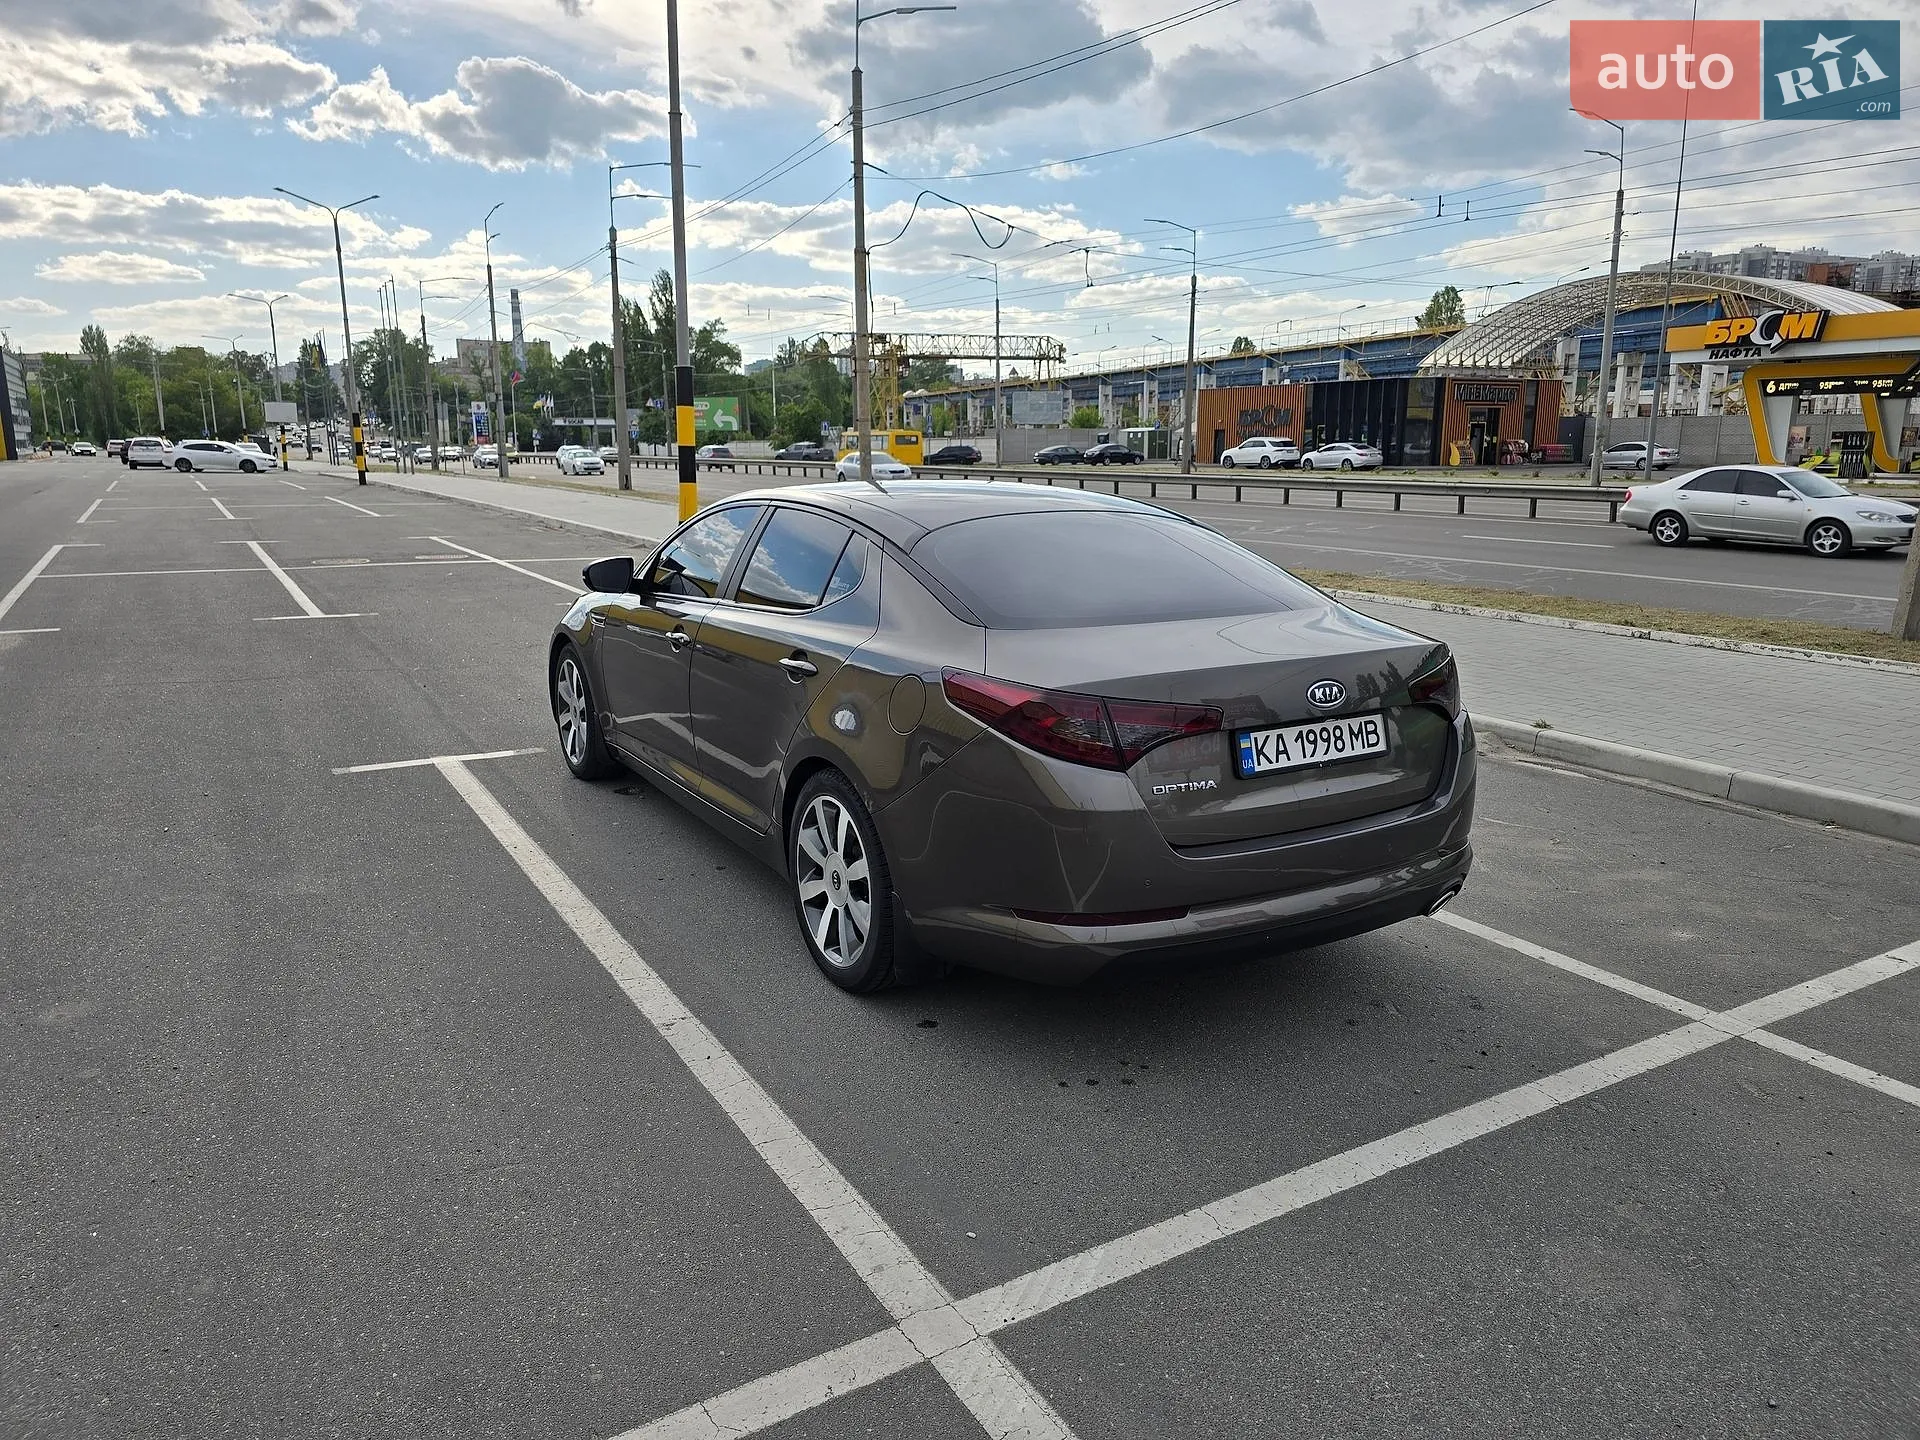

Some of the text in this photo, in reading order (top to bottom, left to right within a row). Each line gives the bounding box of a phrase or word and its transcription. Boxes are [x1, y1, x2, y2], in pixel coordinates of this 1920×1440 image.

[1704, 310, 1820, 347] БРСМ
[1709, 347, 1762, 360] НАФТА
[1766, 381, 1776, 393] 6
[1314, 686, 1341, 702] KIA
[1254, 733, 1292, 767] KA
[1294, 724, 1346, 760] 1998
[1347, 719, 1380, 751] MB
[1242, 759, 1254, 769] UA
[1152, 779, 1218, 796] OPTIMA
